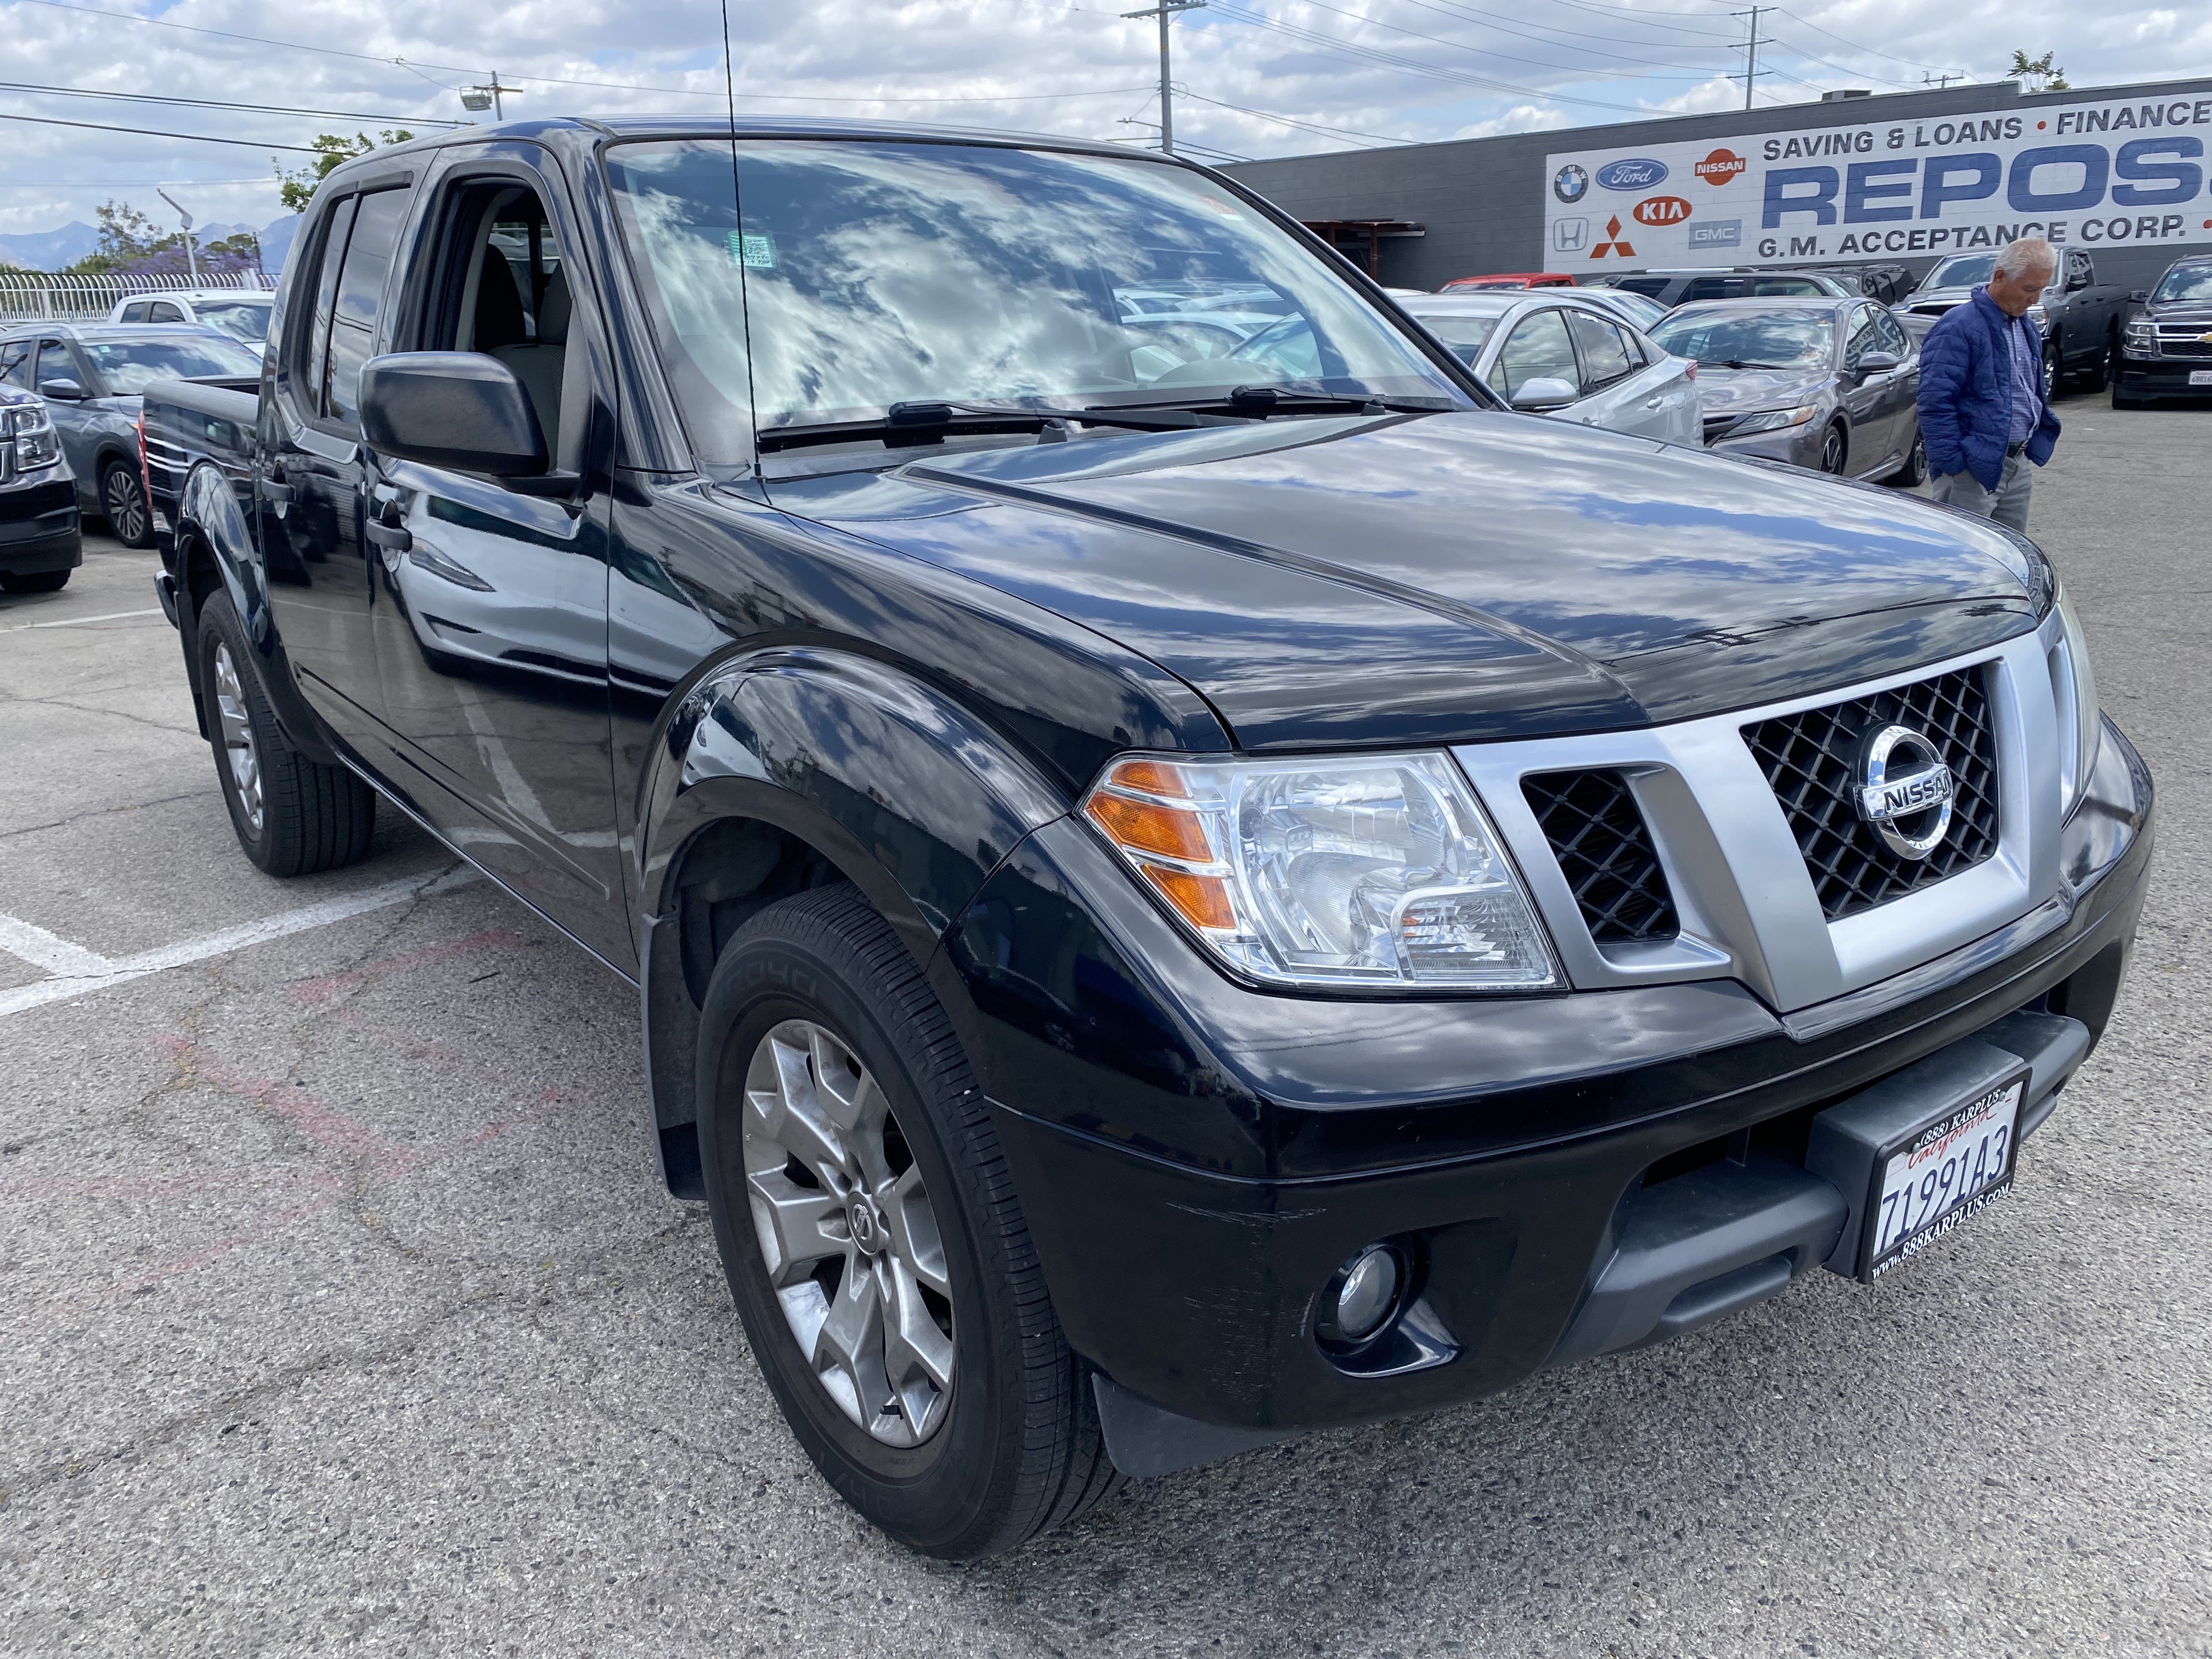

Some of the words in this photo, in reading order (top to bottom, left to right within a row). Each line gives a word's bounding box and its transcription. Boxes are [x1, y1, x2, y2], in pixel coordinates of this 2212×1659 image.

[1763, 131, 1874, 161] SAVING
[1887, 128, 1905, 149] &
[1915, 117, 2023, 148] LOANS
[2057, 100, 2212, 135] FINANCE
[1611, 165, 1654, 184] Ford
[1697, 160, 1743, 174] NISSAN
[1762, 136, 2212, 229] REPOS
[1642, 201, 1684, 221] KIA
[1695, 227, 1735, 241] GMC
[1758, 236, 1825, 258] G.M.
[1838, 221, 2068, 254] ACCEPTANCE
[2080, 215, 2186, 241] CORP.
[1882, 769, 1952, 812] NISSAN
[1908, 1107, 1997, 1170] California
[1921, 1121, 1949, 1147] (888)
[1950, 1089, 2001, 1131] KARPLUS
[1880, 1125, 2008, 1252] 71991A3
